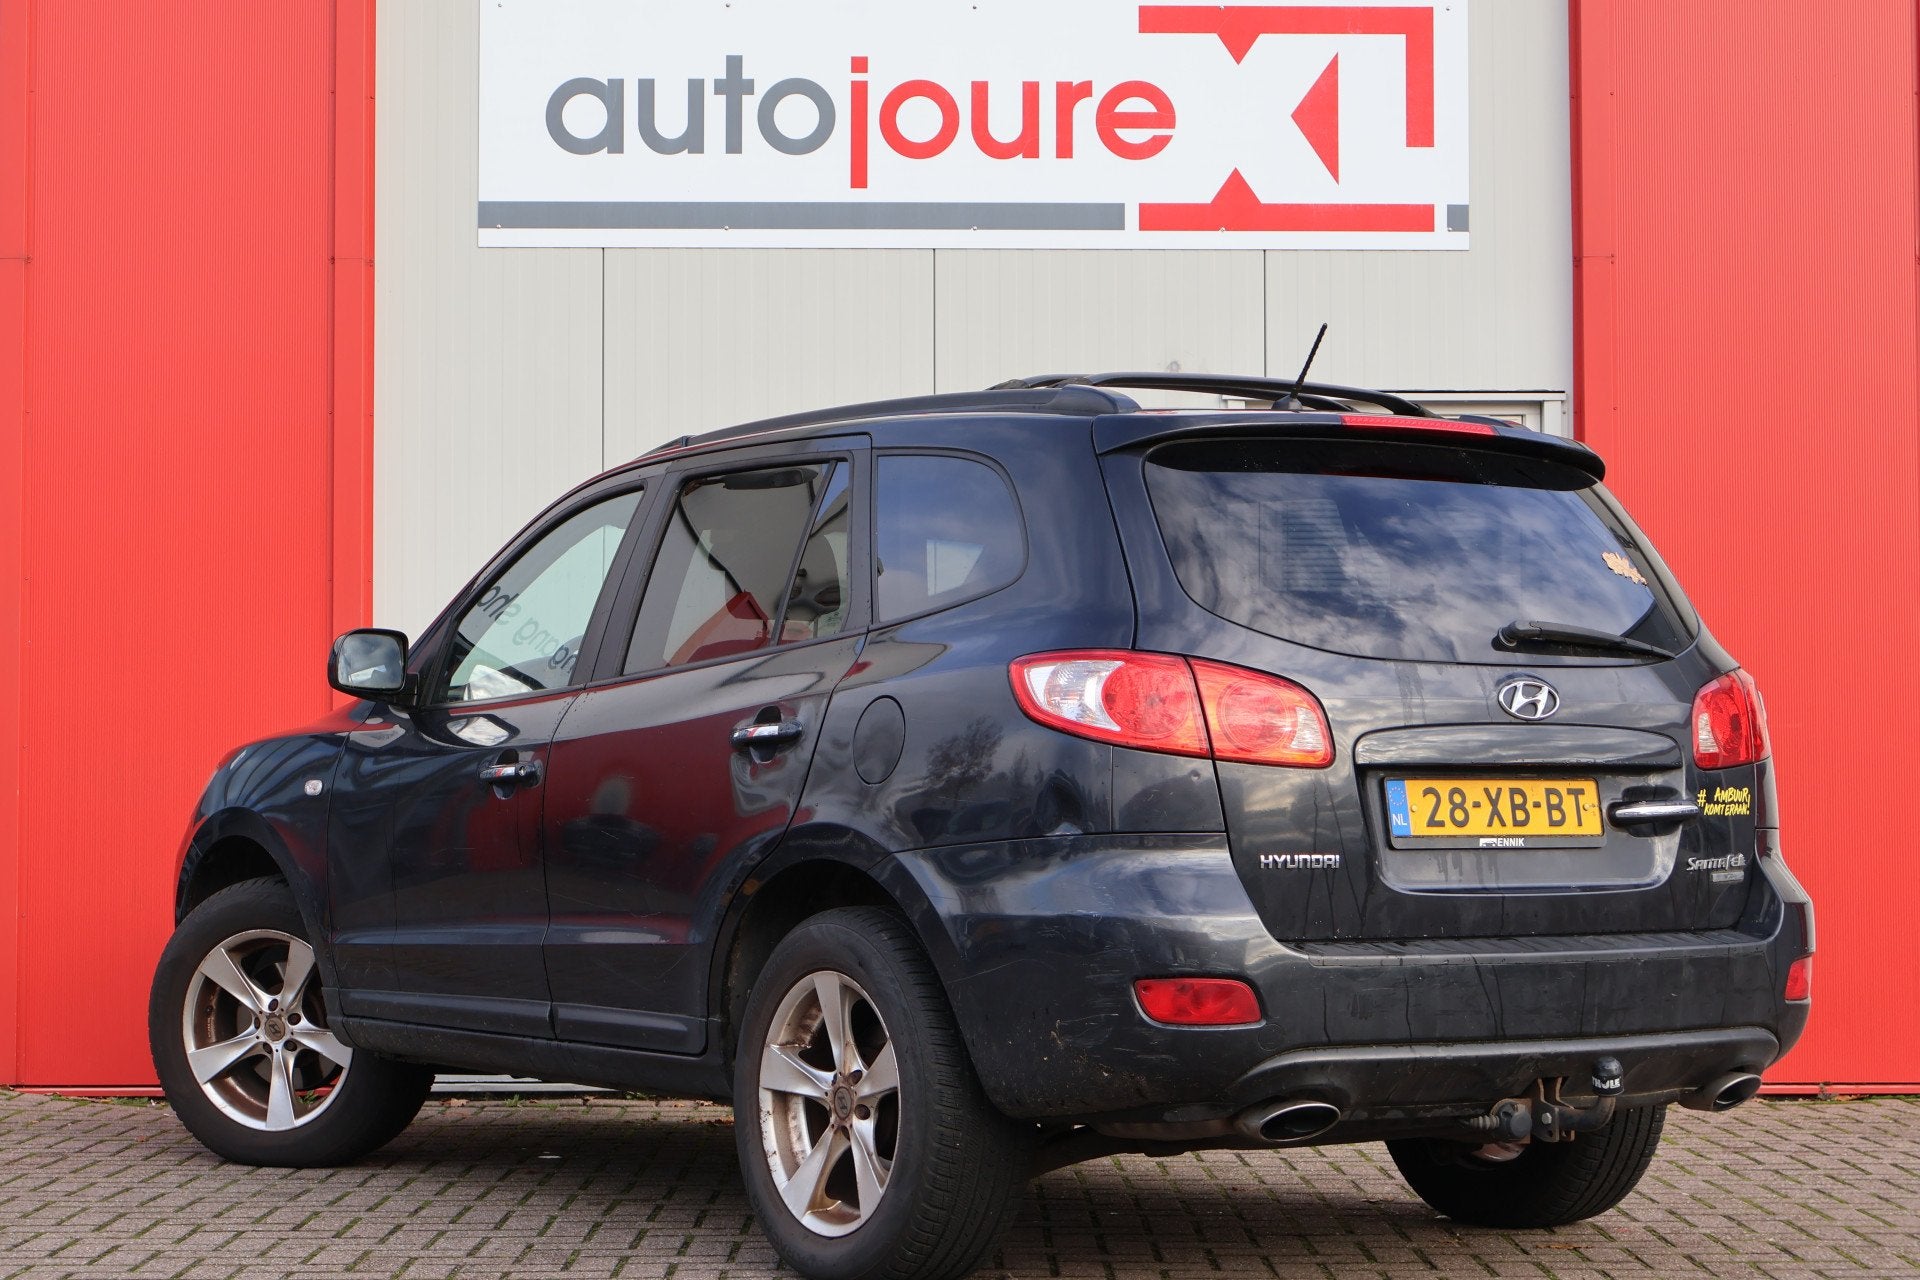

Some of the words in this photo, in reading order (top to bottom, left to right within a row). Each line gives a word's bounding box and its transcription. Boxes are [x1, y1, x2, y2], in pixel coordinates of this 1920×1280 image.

[1421, 786, 1586, 828] 28-XB-BT
[1392, 813, 1408, 827] NL
[1260, 854, 1340, 869] HYUNDAI
